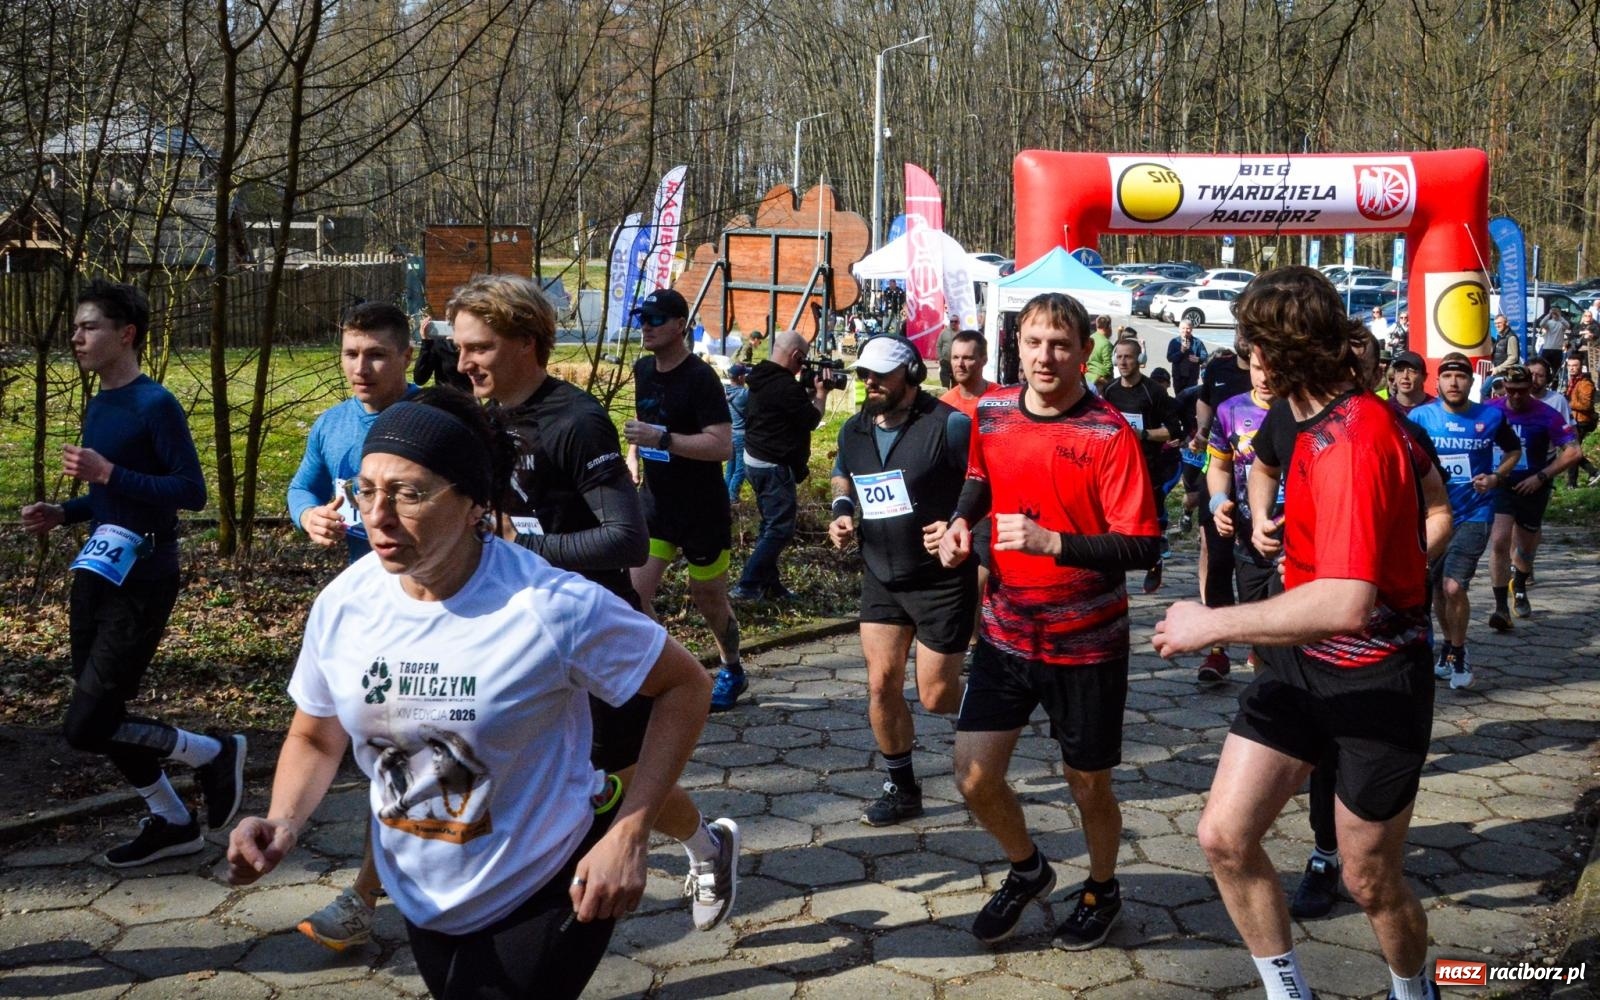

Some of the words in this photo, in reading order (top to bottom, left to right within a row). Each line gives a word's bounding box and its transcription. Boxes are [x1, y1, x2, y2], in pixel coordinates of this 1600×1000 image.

[1239, 163, 1291, 176] BIEG
[1198, 184, 1337, 201] TWARDZIELA
[1209, 205, 1322, 223] RACIBÓRZ
[1430, 436, 1491, 451] UNNERS
[863, 484, 895, 504] 102
[83, 539, 125, 564] 094
[399, 661, 440, 675] TROPEM
[398, 675, 477, 697] WILCZYM
[413, 707, 448, 721] EDYCJA
[449, 708, 476, 721] 2026
